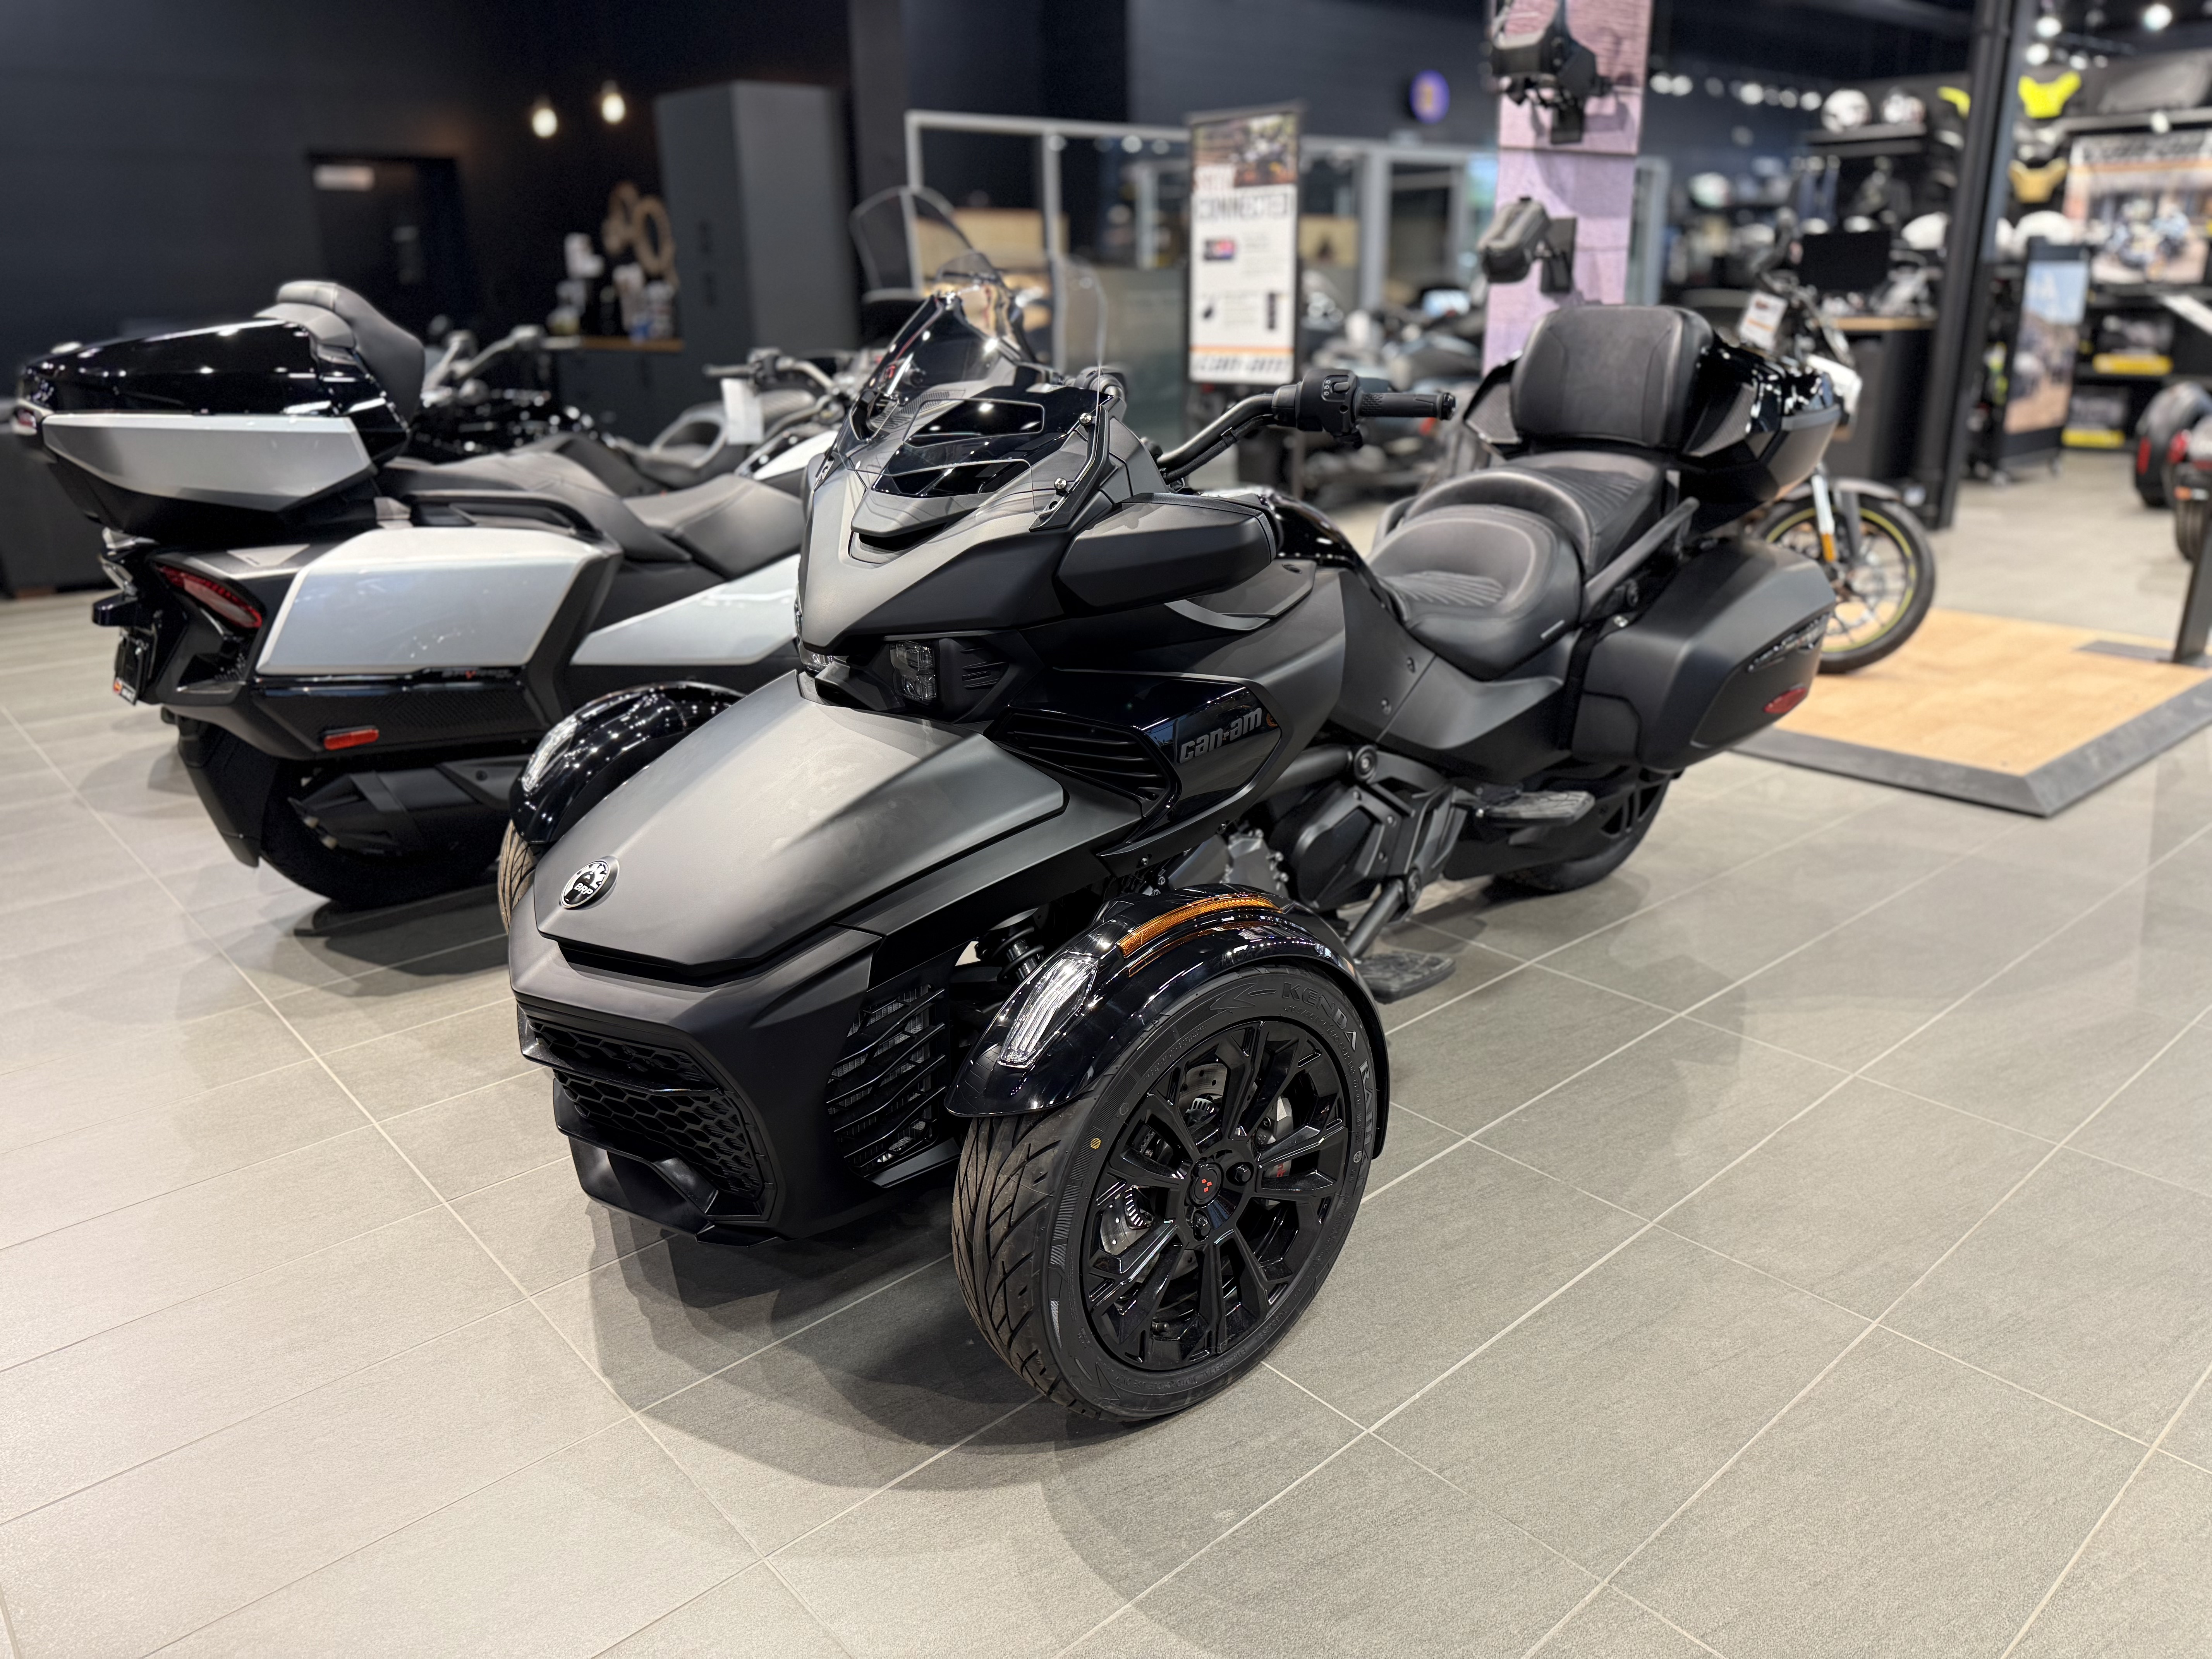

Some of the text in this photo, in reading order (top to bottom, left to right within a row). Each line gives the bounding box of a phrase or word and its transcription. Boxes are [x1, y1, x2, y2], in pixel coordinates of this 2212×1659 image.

[1179, 708, 1262, 763] can-am
[574, 883, 593, 895] BRP
[1282, 981, 1374, 1196] KENDA RADIAL
[1231, 1347, 1246, 1362] FOR
[1200, 1358, 1230, 1380] SPECIAL
